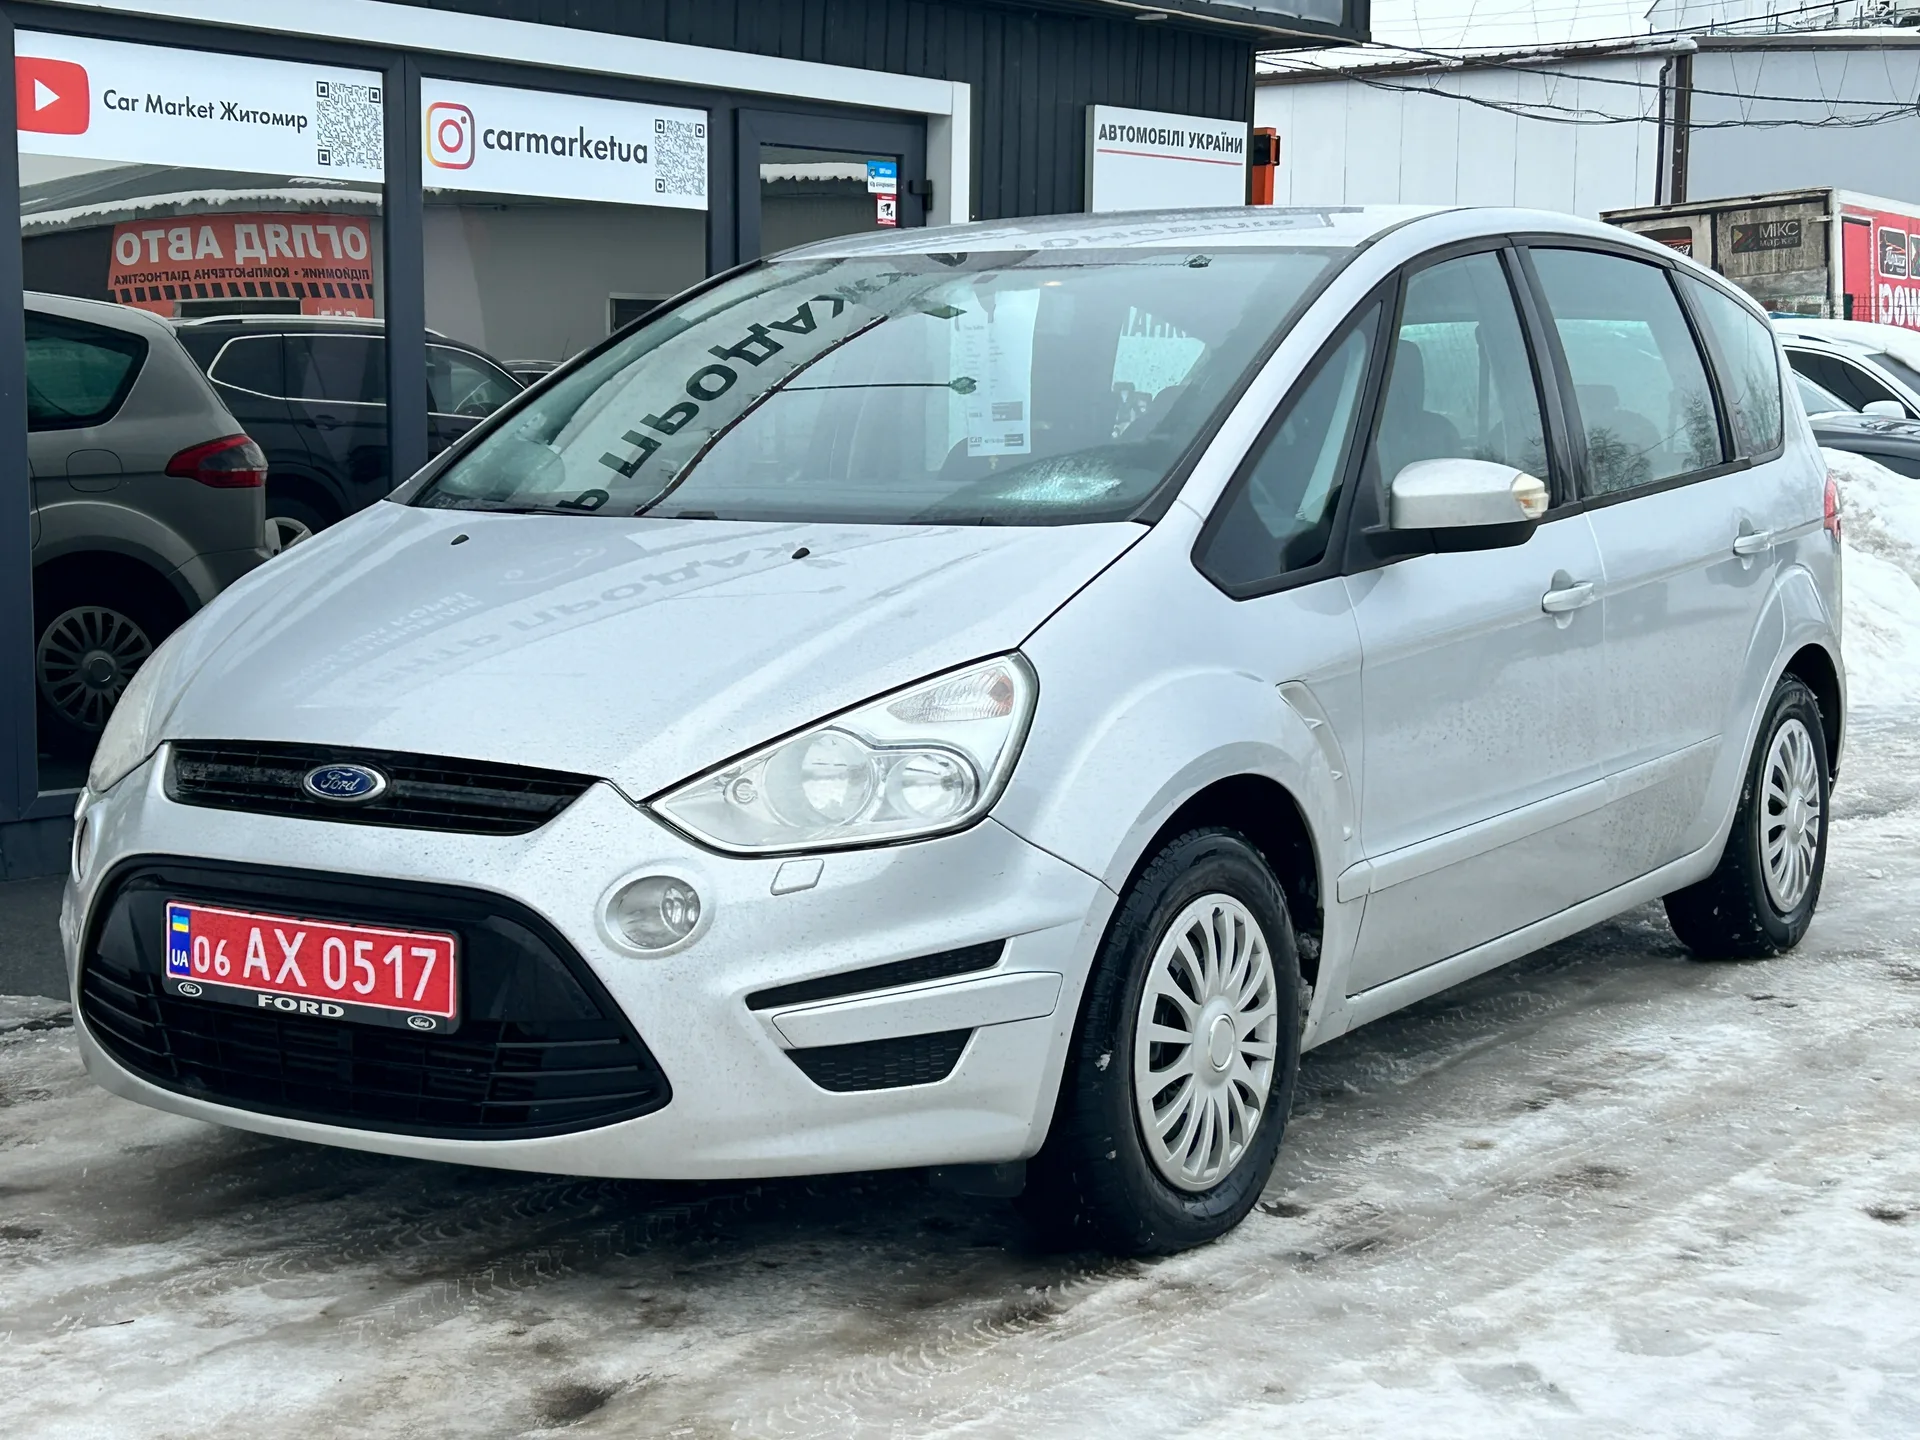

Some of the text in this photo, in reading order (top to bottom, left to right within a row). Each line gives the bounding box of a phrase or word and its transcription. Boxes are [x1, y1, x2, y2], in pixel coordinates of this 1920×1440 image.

[103, 89, 308, 134] Car Market Житомир
[483, 126, 648, 163] carmarketua
[1098, 123, 1243, 154] АВТОМОБІЛІ УКРАЇНИ
[320, 770, 361, 791] Ford
[171, 948, 189, 968] UA
[193, 927, 437, 1001] 06 AX 0517
[258, 994, 345, 1018] FORD
